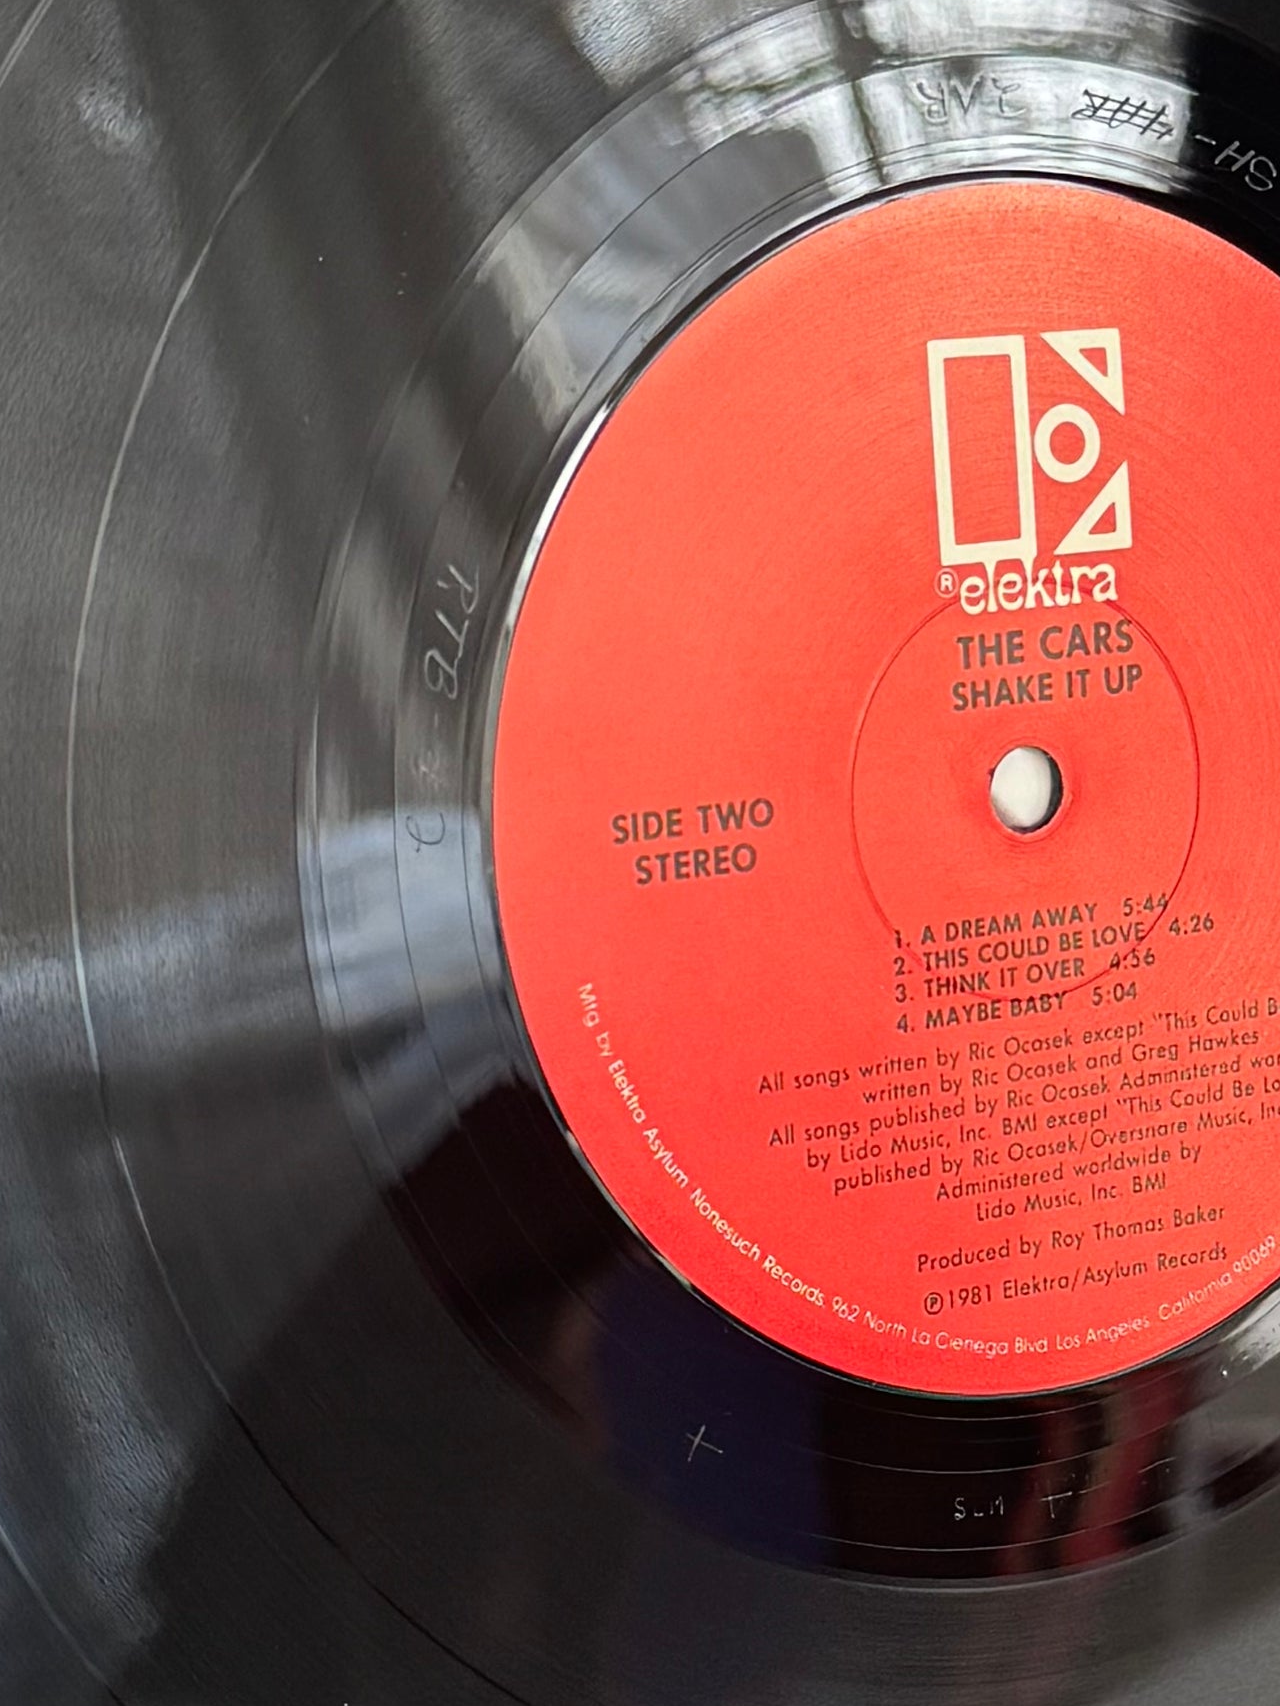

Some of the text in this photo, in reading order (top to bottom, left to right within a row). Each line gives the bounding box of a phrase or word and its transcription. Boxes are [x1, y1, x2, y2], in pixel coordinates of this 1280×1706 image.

[957, 619, 1134, 669] THE CARS
[951, 663, 1143, 711] SHAKE IT UP
[612, 797, 774, 844] SIDE TWO
[635, 842, 757, 885] STEREO
[921, 926, 936, 945] A
[945, 913, 1022, 941] DREAM
[1031, 903, 1098, 927] AWAY
[1123, 893, 1169, 916] 5:44
[894, 957, 913, 976] 2.
[923, 948, 969, 973] THIS
[978, 935, 1050, 963] COULD
[1059, 932, 1083, 953] BE
[1092, 921, 1146, 946] LOVE
[895, 984, 914, 1003] 3.
[923, 971, 990, 998] THINK
[999, 968, 1018, 987] IT
[1026, 958, 1085, 984] OVER
[896, 981, 1137, 1034] 4. MAYBE BABY 5:04
[759, 1072, 784, 1094] All
[794, 1067, 850, 1089] songs
[859, 1055, 928, 1078] written
[936, 1047, 960, 1070] by
[969, 1041, 996, 1062] Ric
[1004, 1027, 1073, 1056] Ocasek
[1082, 1021, 1144, 1045] except
[1206, 1000, 1259, 1025] Could
[863, 1029, 1260, 1105] written by Ric Ocasek and Greg Hawkes
[770, 1124, 795, 1147] All
[804, 1120, 860, 1142] songs
[870, 1097, 965, 1137] published
[975, 1094, 998, 1116] by
[1006, 1089, 1033, 1109] Ric
[1119, 1058, 1241, 1091] Administered
[807, 1149, 831, 1172] by
[841, 1142, 882, 1164] Lido
[890, 1131, 951, 1155] Music,
[1003, 1113, 1038, 1136] BMI
[1046, 1104, 1108, 1130] except
[1169, 1083, 1224, 1109] Could
[1232, 1079, 1256, 1098] Be
[834, 1155, 931, 1196] published
[941, 1154, 964, 1177] by
[973, 1147, 1000, 1168] Ric
[1197, 1108, 1253, 1132] Music,
[936, 1143, 1202, 1202] Administered worldwide by
[596, 1031, 613, 1057] by
[608, 1059, 647, 1124] Elektra
[643, 1126, 689, 1189] Asylum
[689, 1188, 762, 1262] Nonesuch
[831, 1295, 860, 1324] 962
[864, 1311, 907, 1336] North
[911, 1327, 930, 1347] La
[1055, 1332, 1081, 1351] Los
[1086, 1315, 1150, 1344] Angeles
[1232, 1235, 1276, 1274] 90069
[976, 1202, 1016, 1222] Lido
[1024, 1190, 1082, 1213] Music,
[1132, 1172, 1167, 1193] BMI
[917, 1205, 1225, 1273] Produced by Roy Thomas Baker
[1003, 1260, 1148, 1300] Elektra/Asylum
[1157, 1243, 1228, 1272] Records
